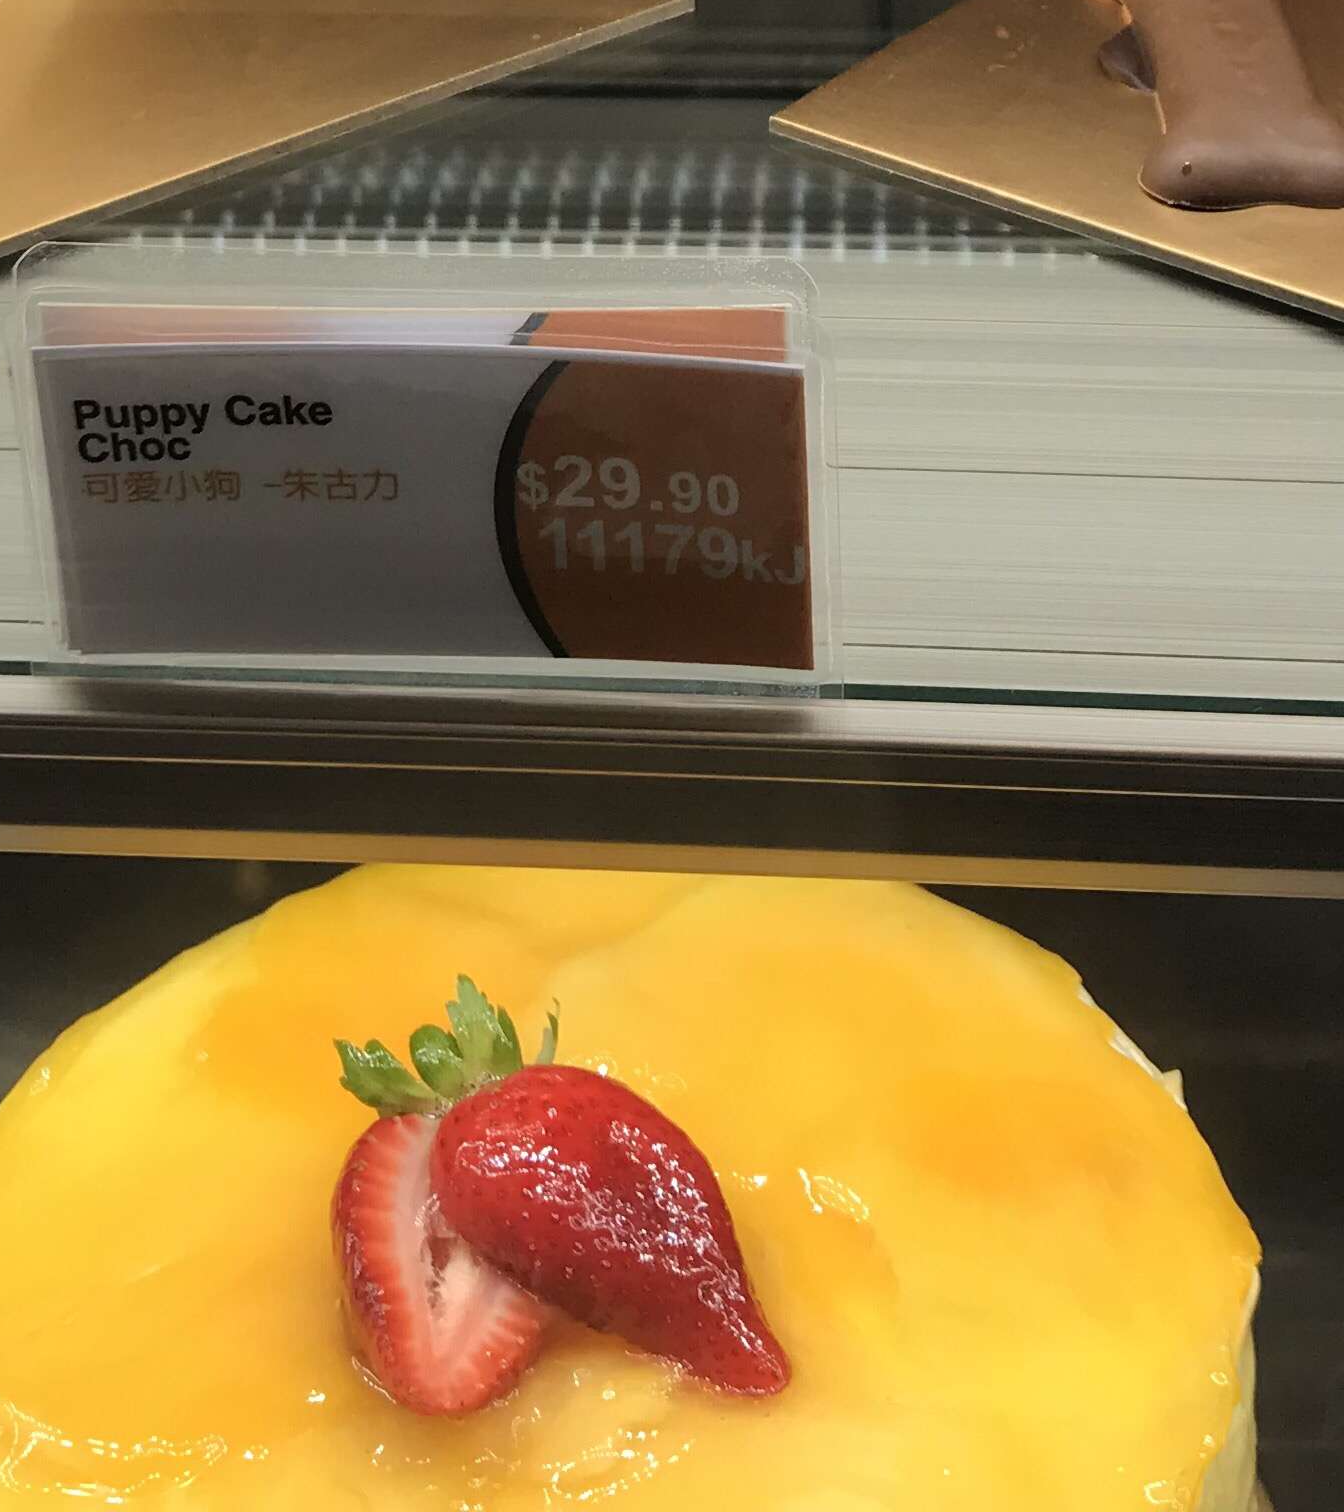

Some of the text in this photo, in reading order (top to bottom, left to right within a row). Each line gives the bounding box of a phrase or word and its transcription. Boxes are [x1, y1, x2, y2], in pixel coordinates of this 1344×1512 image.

[72, 394, 334, 434] Puppy Cake
[78, 432, 192, 464] Choc
[81, 469, 242, 504] 可愛小狗
[516, 454, 740, 518] $29.90
[537, 517, 806, 585] 11179kJ
